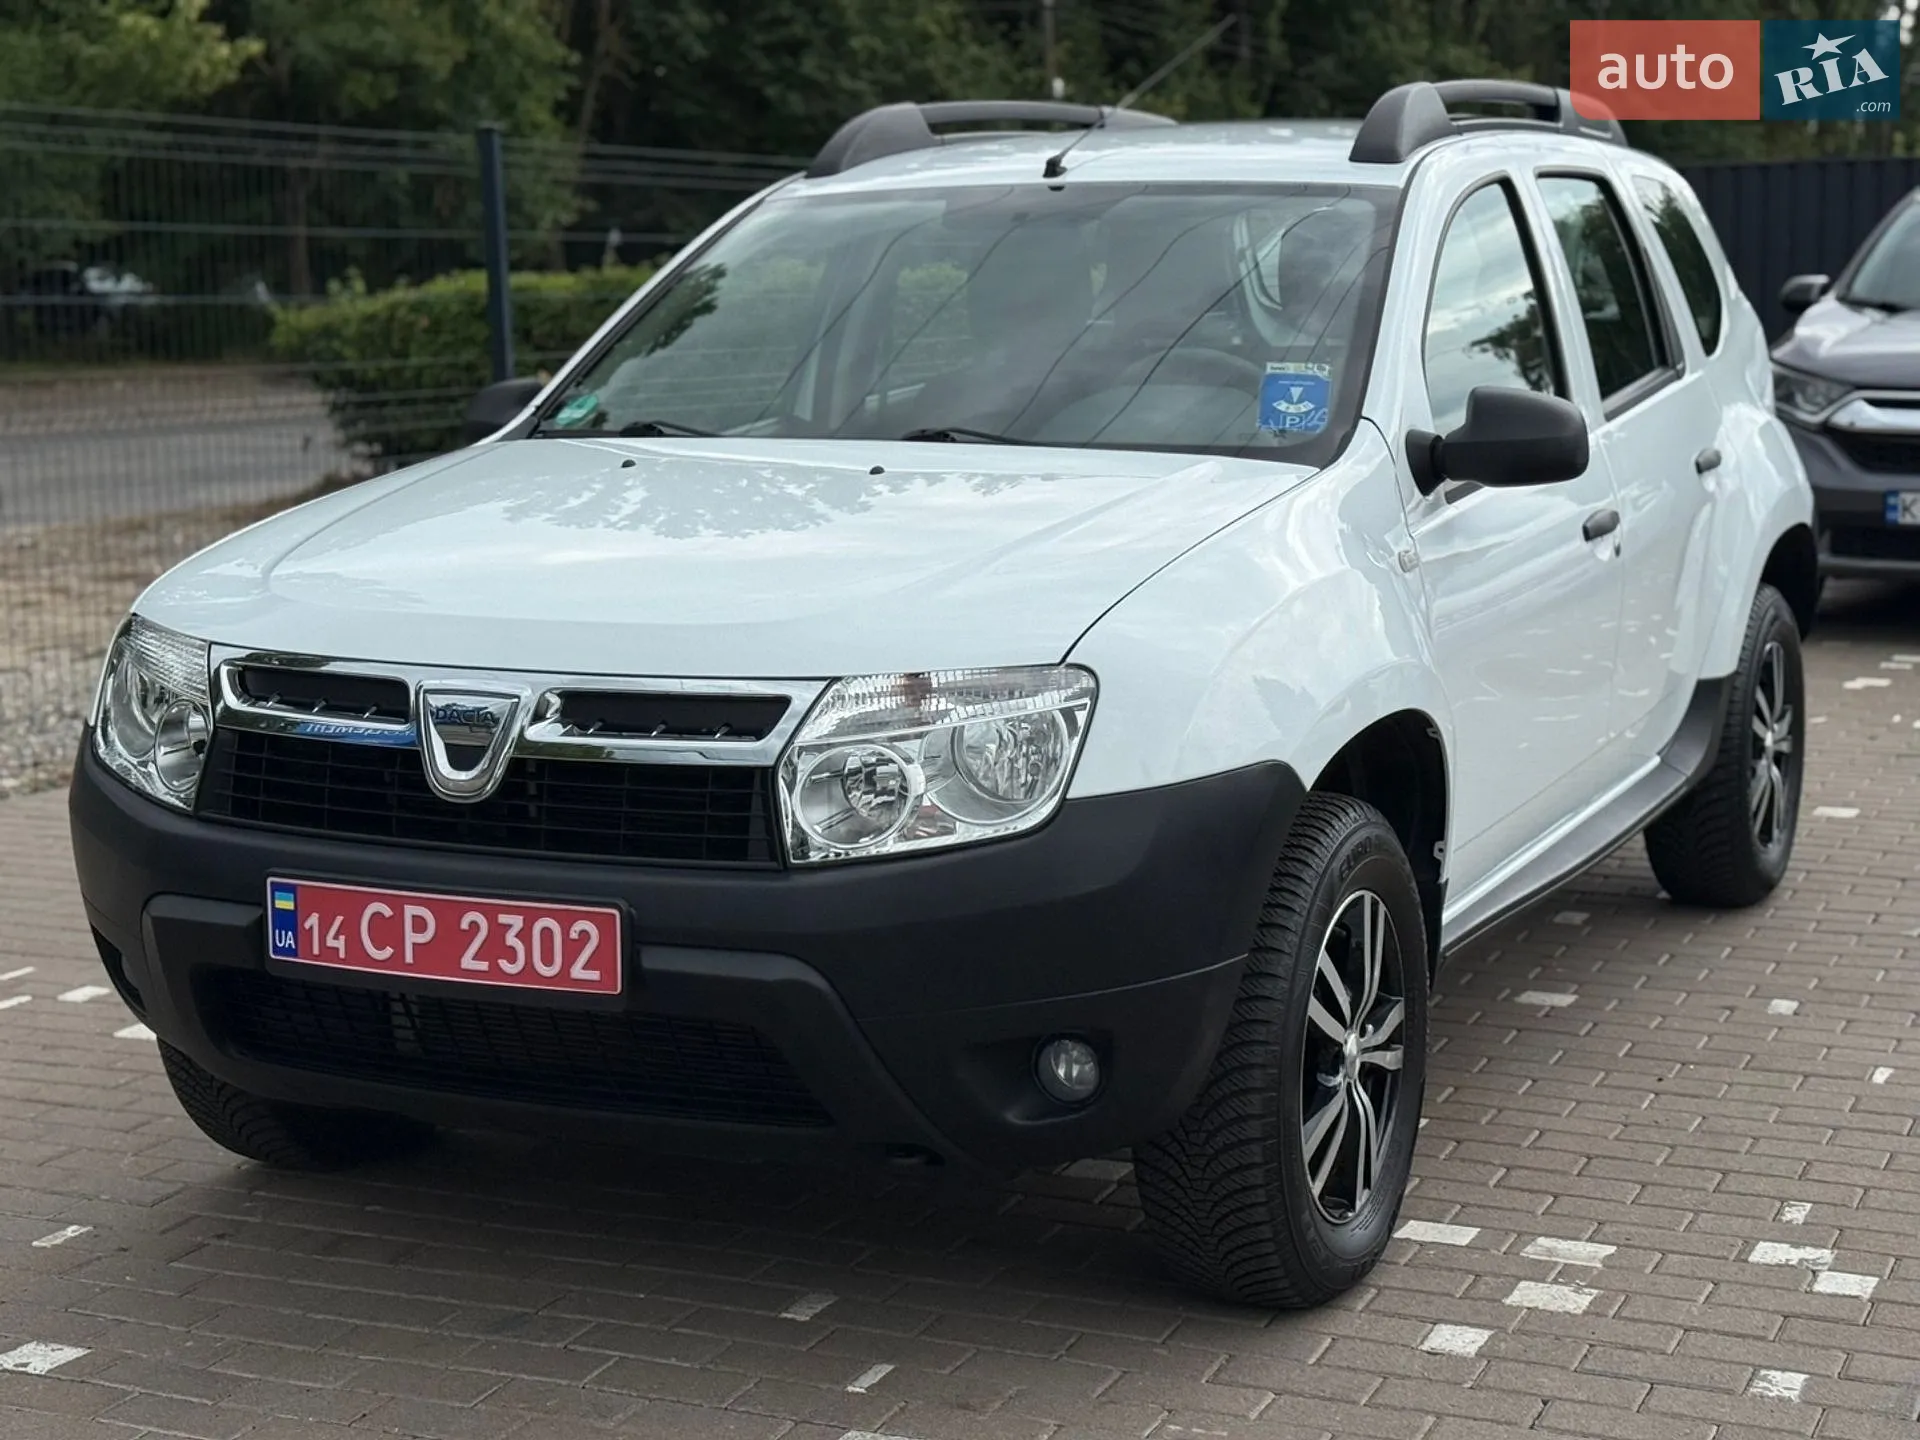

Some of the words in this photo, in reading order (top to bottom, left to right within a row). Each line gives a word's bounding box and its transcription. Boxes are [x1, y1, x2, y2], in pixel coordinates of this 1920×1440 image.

[436, 708, 495, 725] DACIA
[275, 929, 295, 949] UA
[303, 912, 346, 959] 14
[360, 902, 436, 964] CP
[459, 911, 601, 981] 2302
